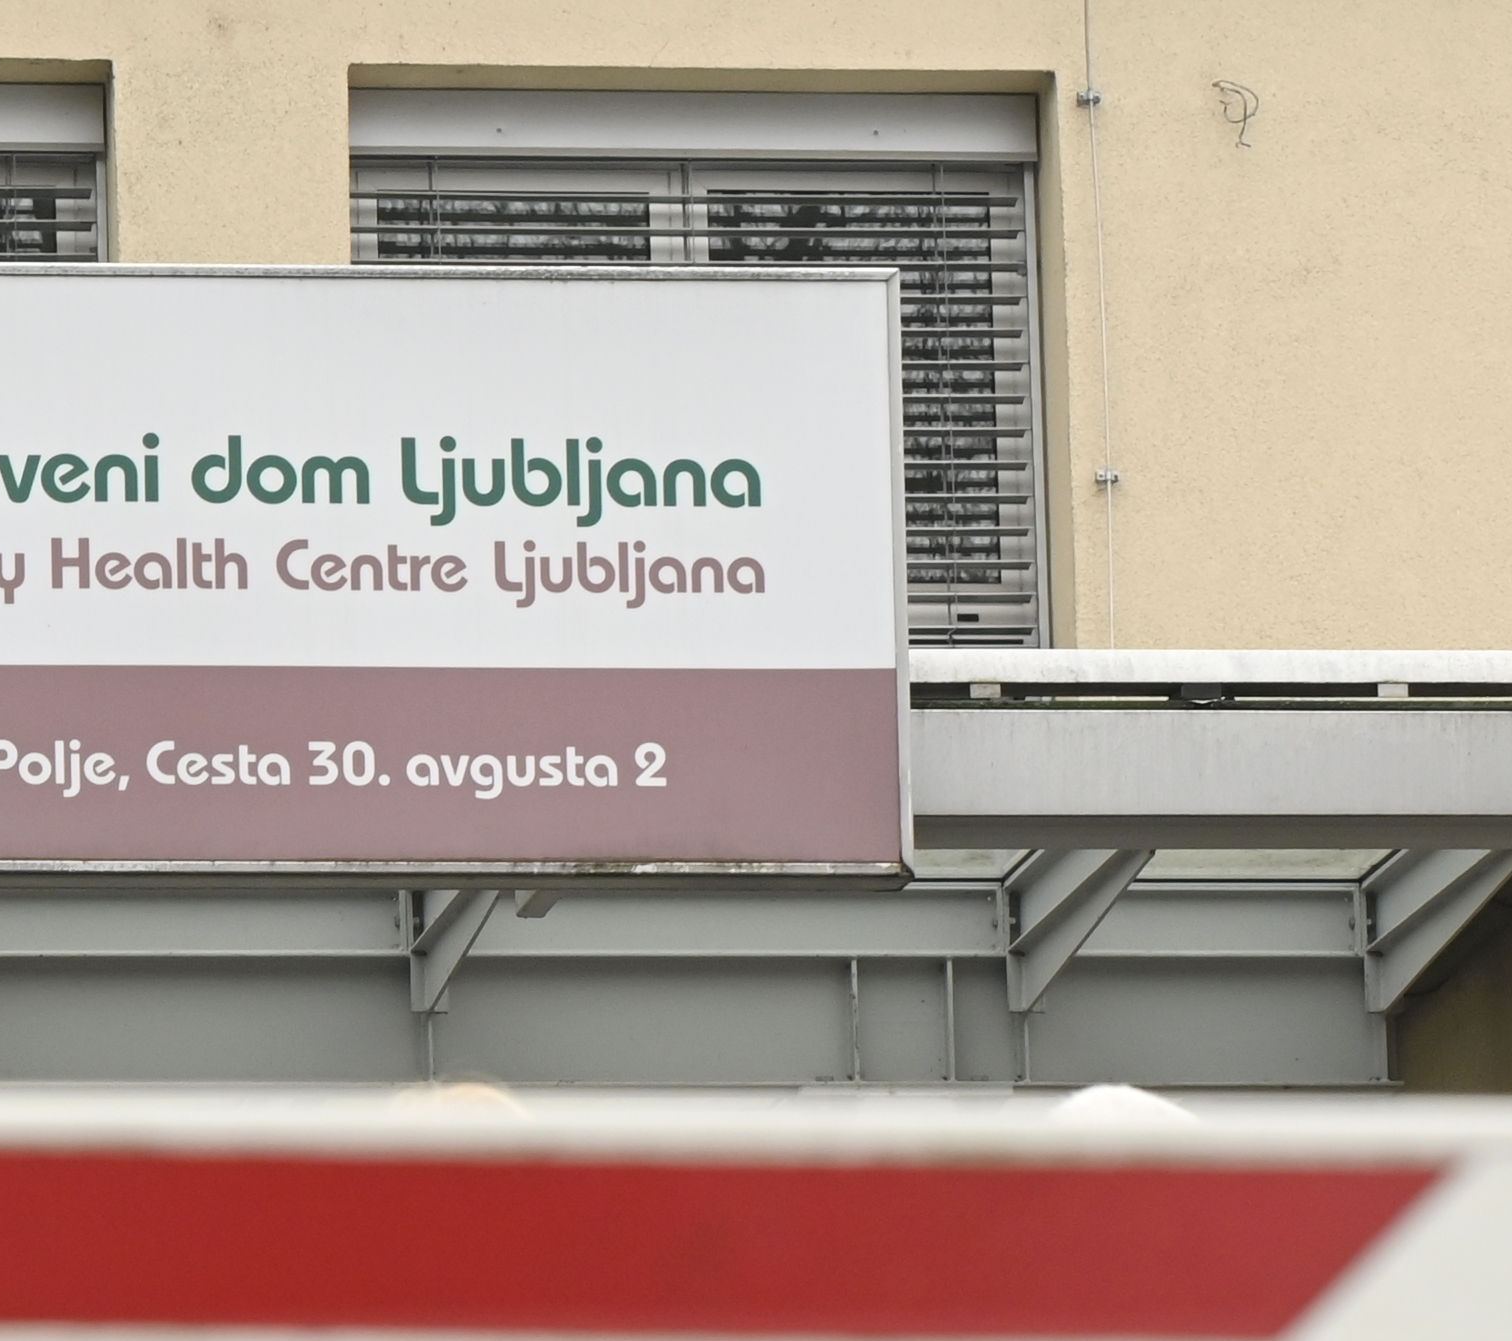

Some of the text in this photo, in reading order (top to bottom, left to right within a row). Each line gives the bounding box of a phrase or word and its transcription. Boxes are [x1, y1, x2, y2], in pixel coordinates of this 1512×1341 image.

[192, 436, 371, 505] dom
[402, 437, 762, 528] Ljubljana
[51, 537, 249, 591] Health
[276, 539, 468, 593] Centre
[494, 541, 766, 610] Ljubljana
[146, 740, 291, 786] Cesta
[308, 741, 391, 786] 30.
[406, 746, 618, 800] avgusta
[634, 743, 667, 787] 2
